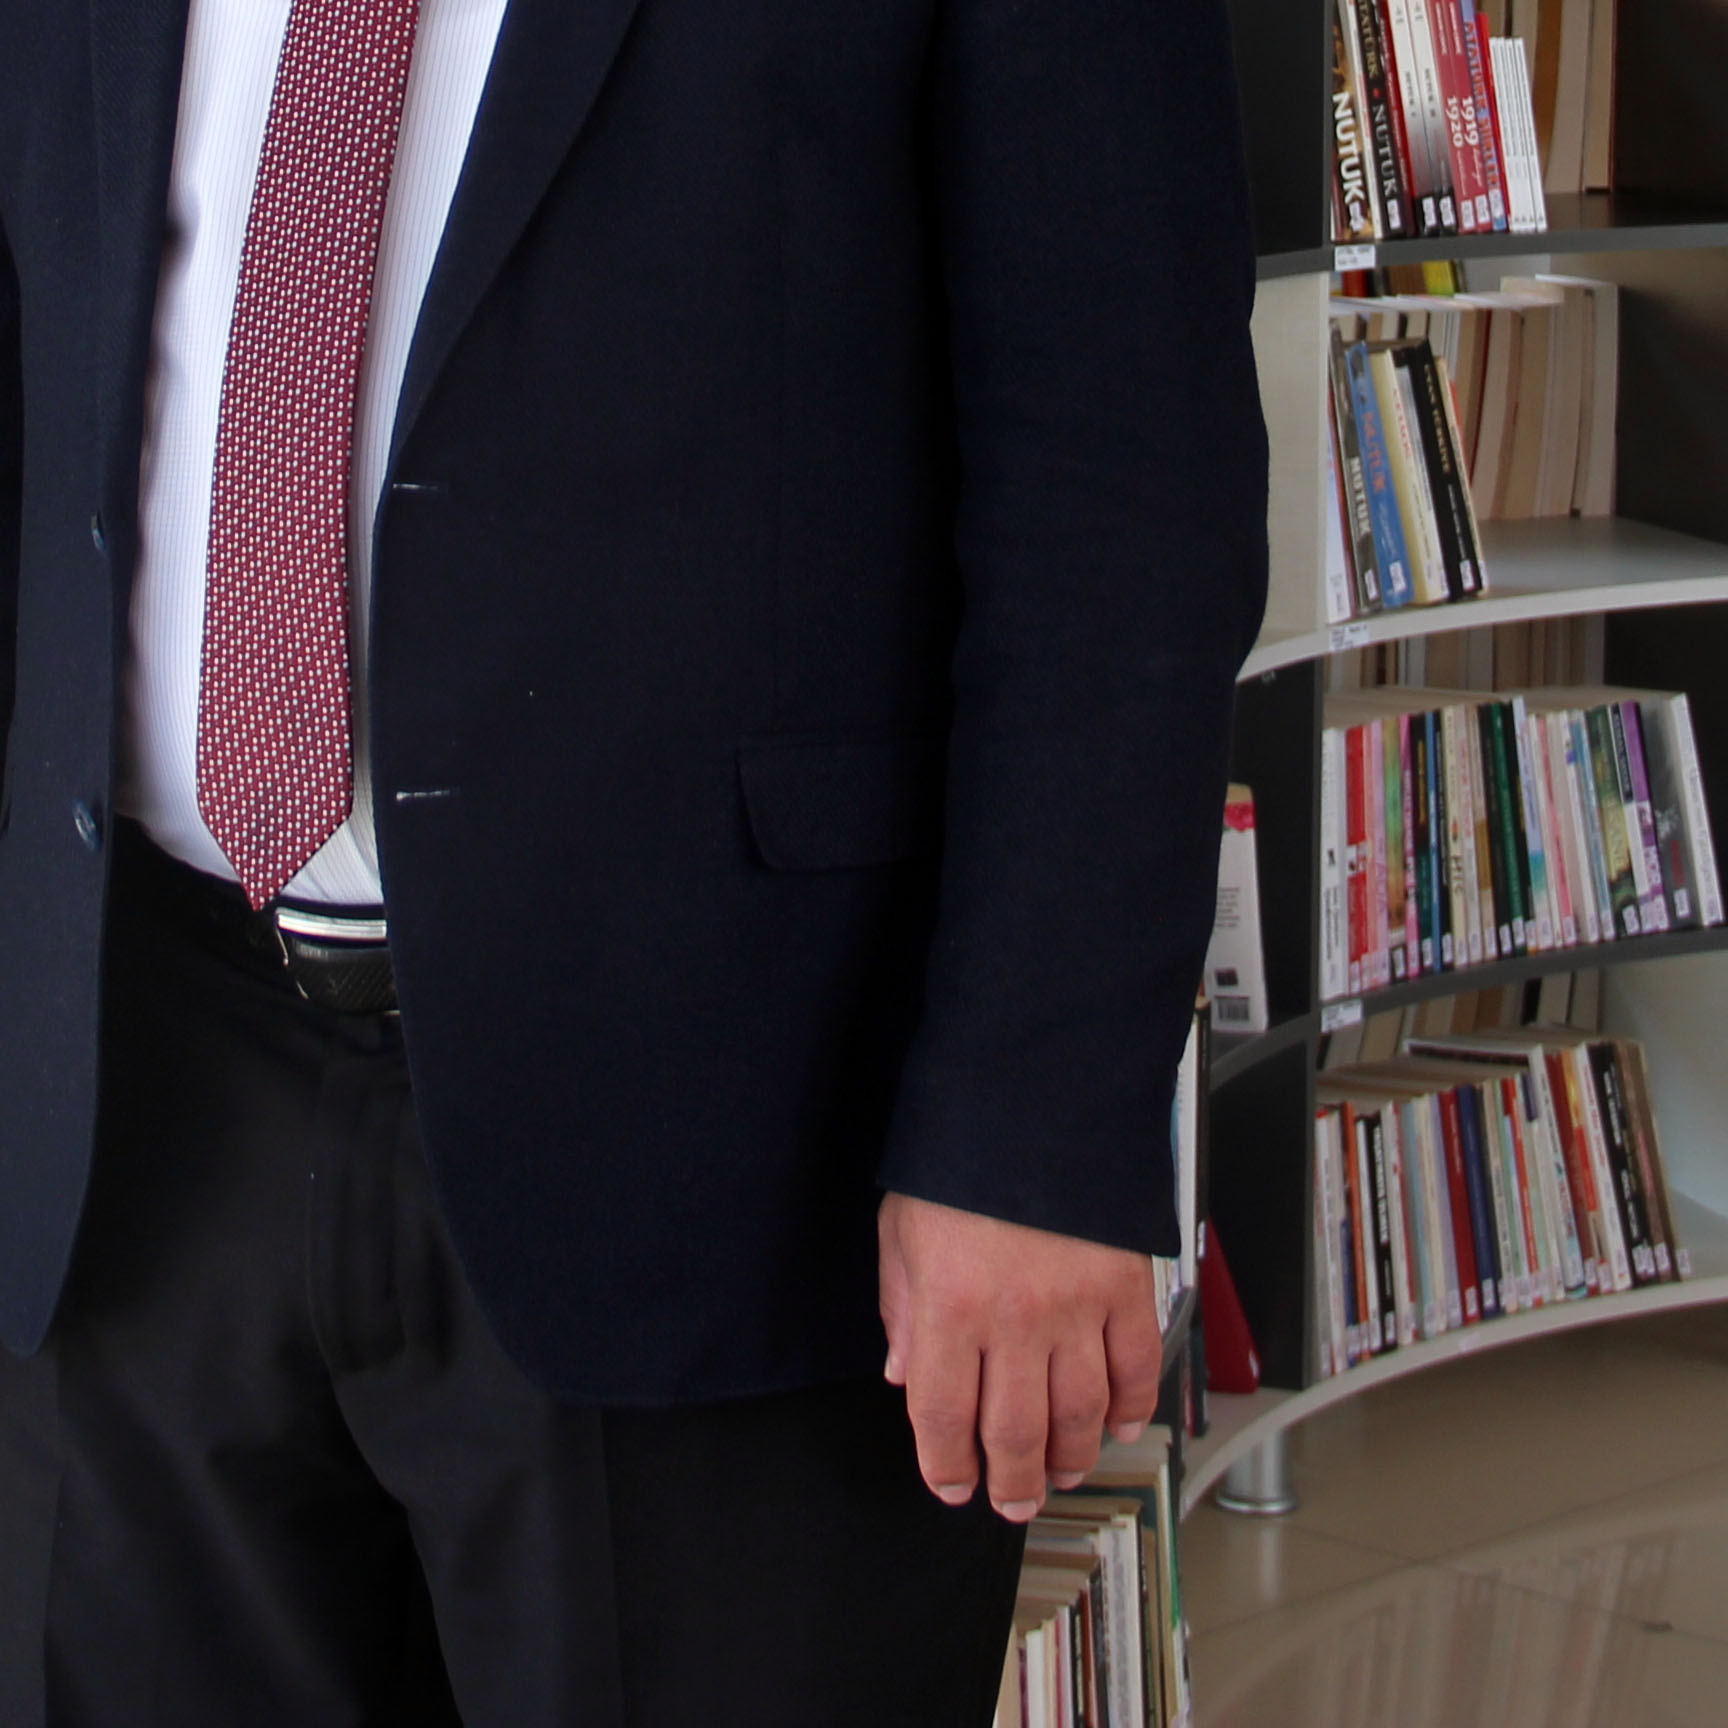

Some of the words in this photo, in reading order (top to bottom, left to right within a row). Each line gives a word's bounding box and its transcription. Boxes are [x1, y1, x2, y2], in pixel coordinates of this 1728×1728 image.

[1332, 91, 1365, 205] NUTUK
[1372, 104, 1398, 197] NUTUK
[1446, 96, 1463, 149] 1920
[1462, 96, 1480, 146] 1919
